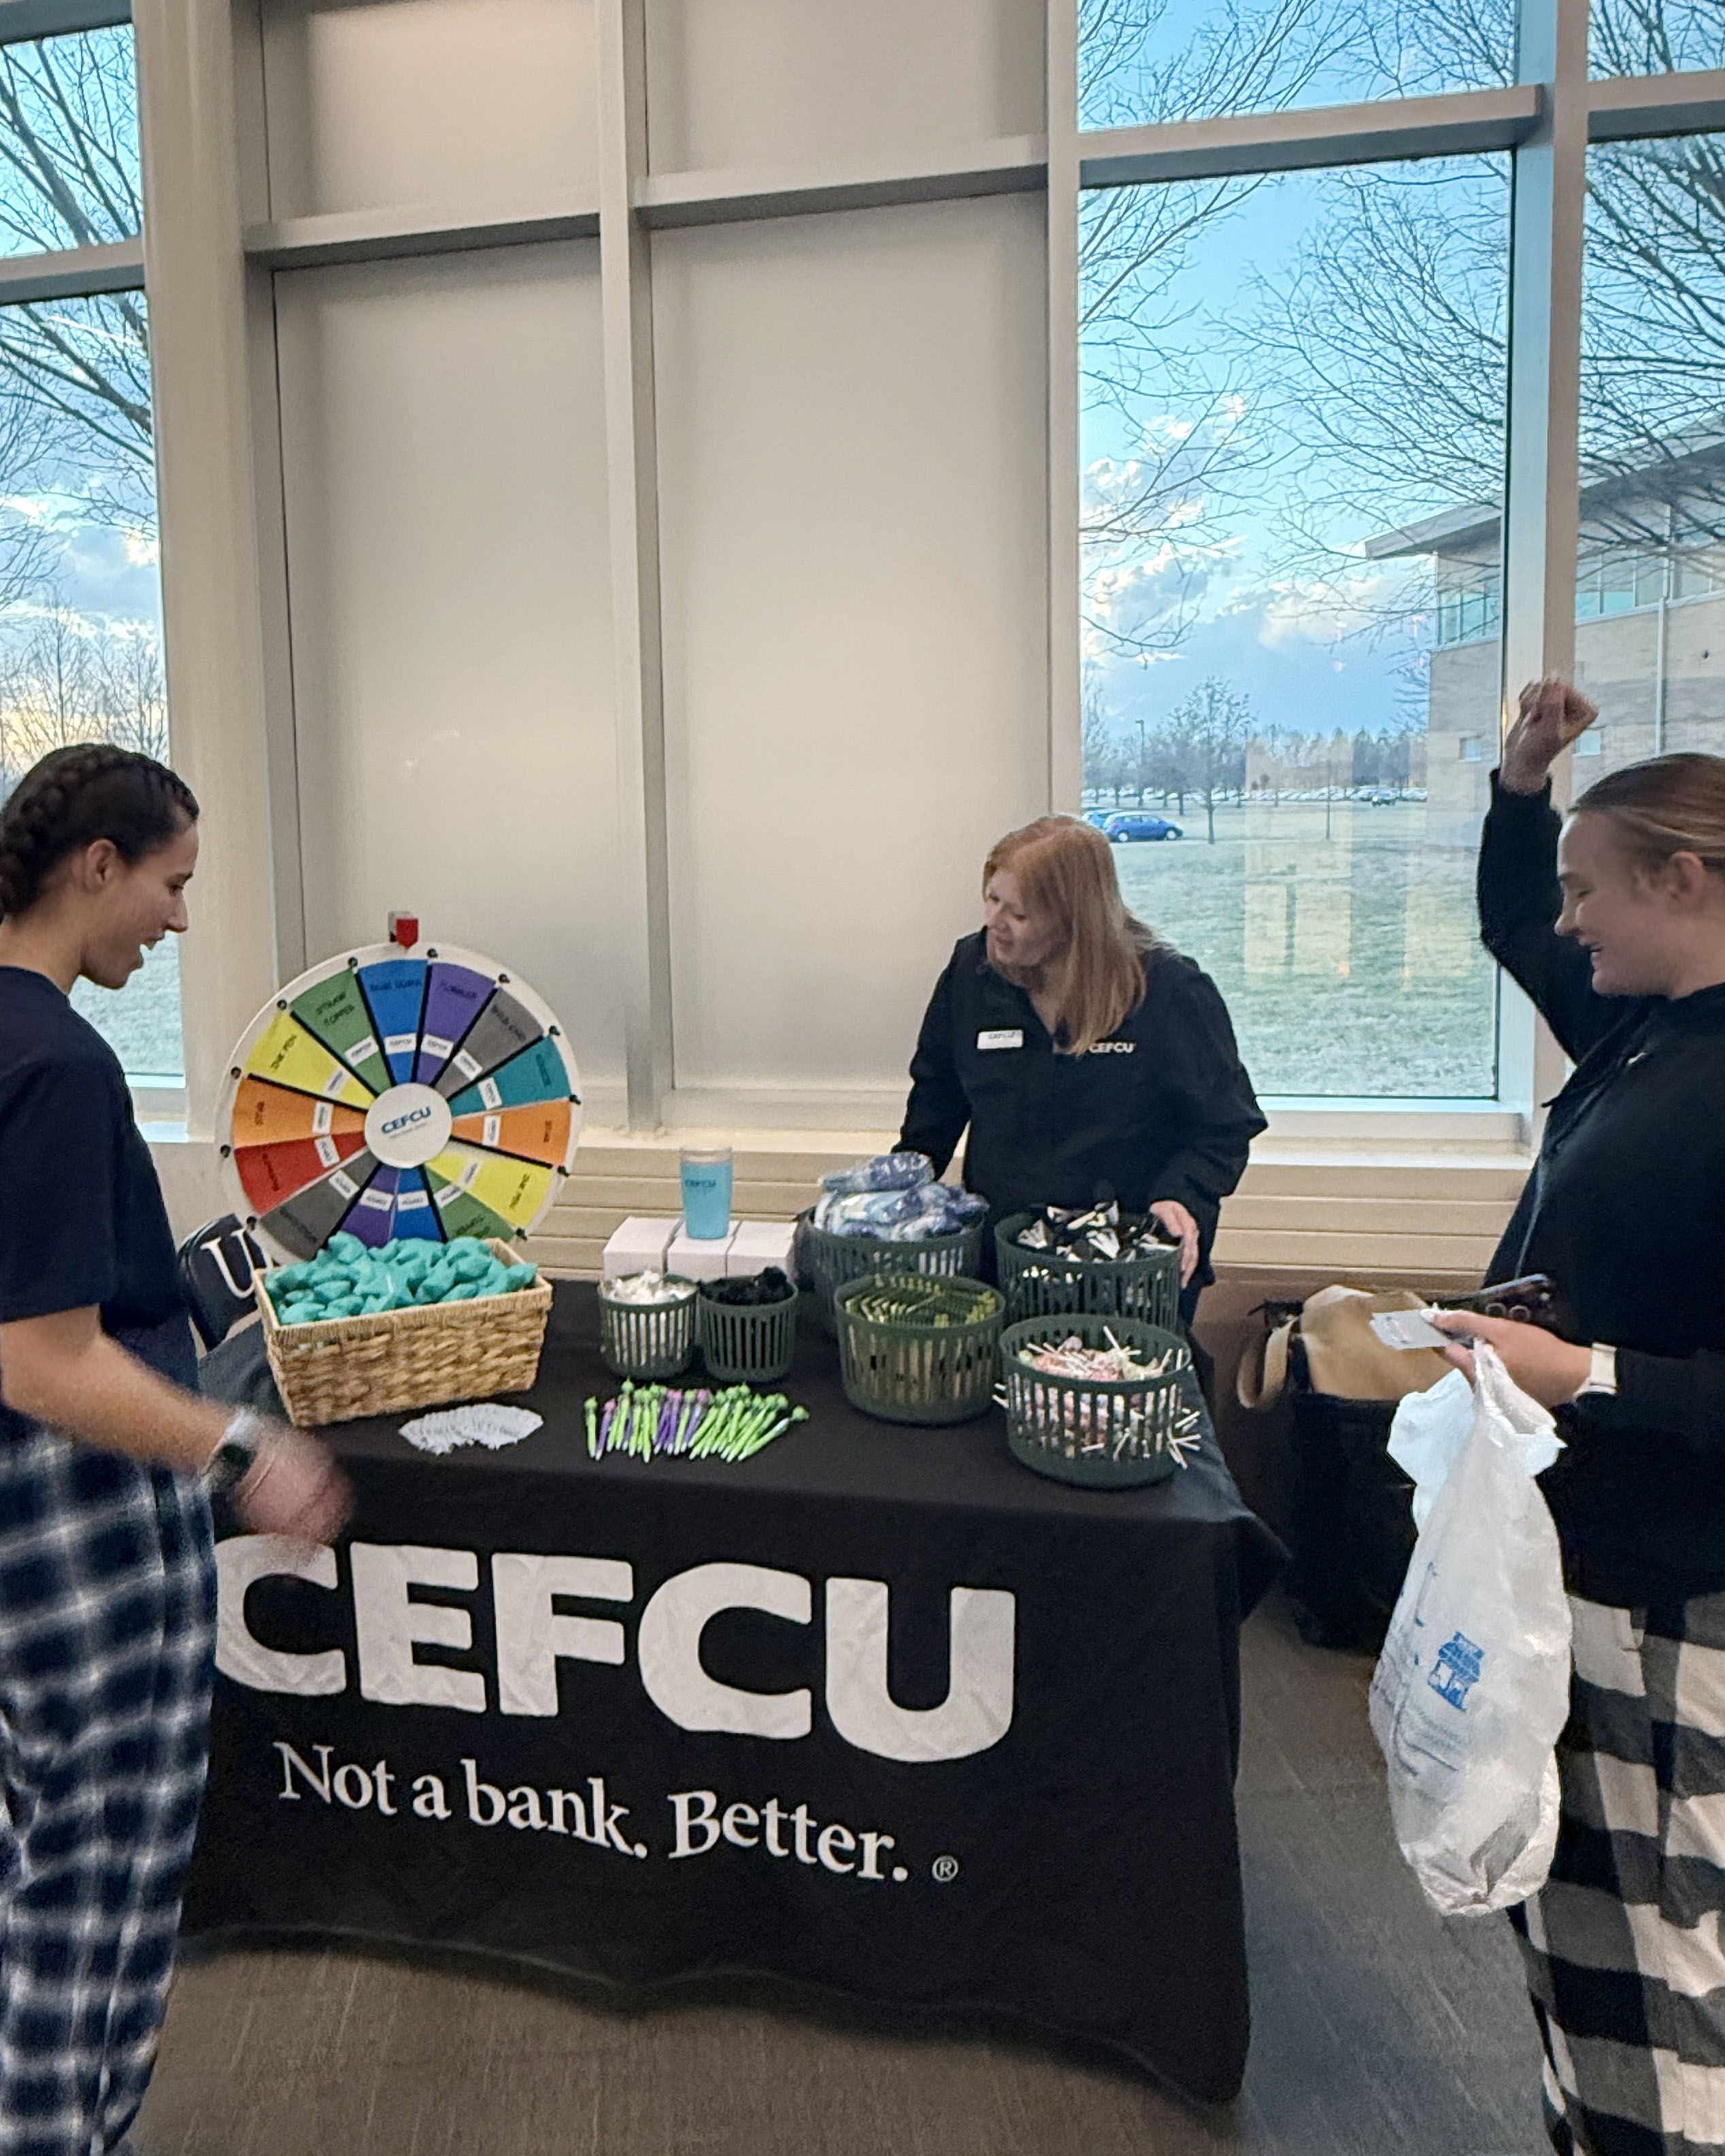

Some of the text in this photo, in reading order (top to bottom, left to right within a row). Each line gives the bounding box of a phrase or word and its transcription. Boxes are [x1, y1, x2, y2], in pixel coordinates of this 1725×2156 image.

[1089, 1042, 1135, 1054] CEFCU
[380, 1105, 432, 1134] CEFCU
[212, 1532, 1016, 1762] CEFCU
[273, 1742, 397, 1815] Not
[412, 1775, 452, 1820] a
[460, 1759, 648, 1859] bank.
[667, 1790, 909, 1882] Better.
